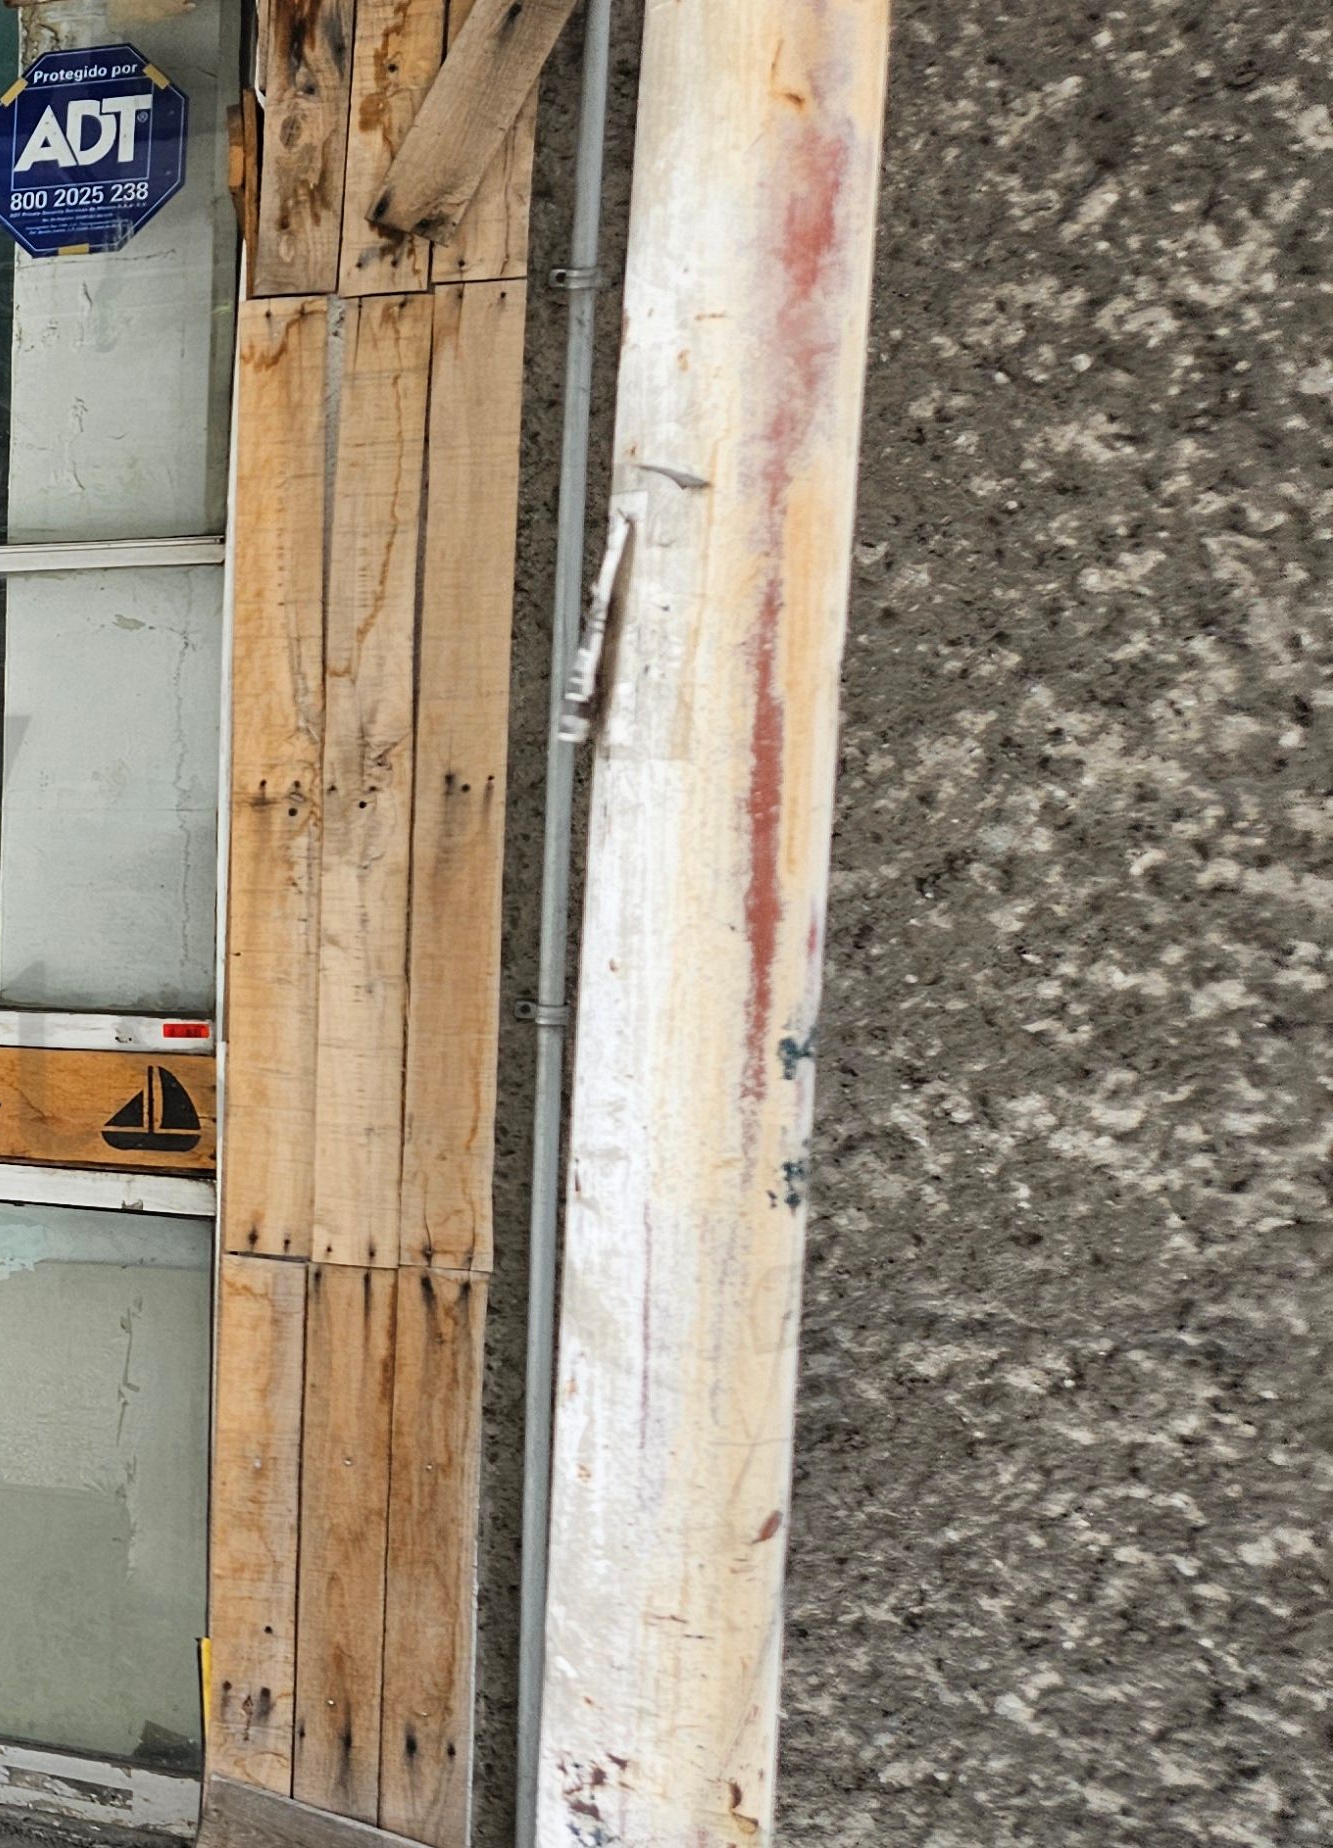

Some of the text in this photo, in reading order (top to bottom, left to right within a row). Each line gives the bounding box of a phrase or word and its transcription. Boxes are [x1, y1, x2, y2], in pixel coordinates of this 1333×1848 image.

[33, 63, 138, 85] Protegido por
[14, 93, 153, 173] ADT
[10, 182, 149, 211] 800 2025 238
